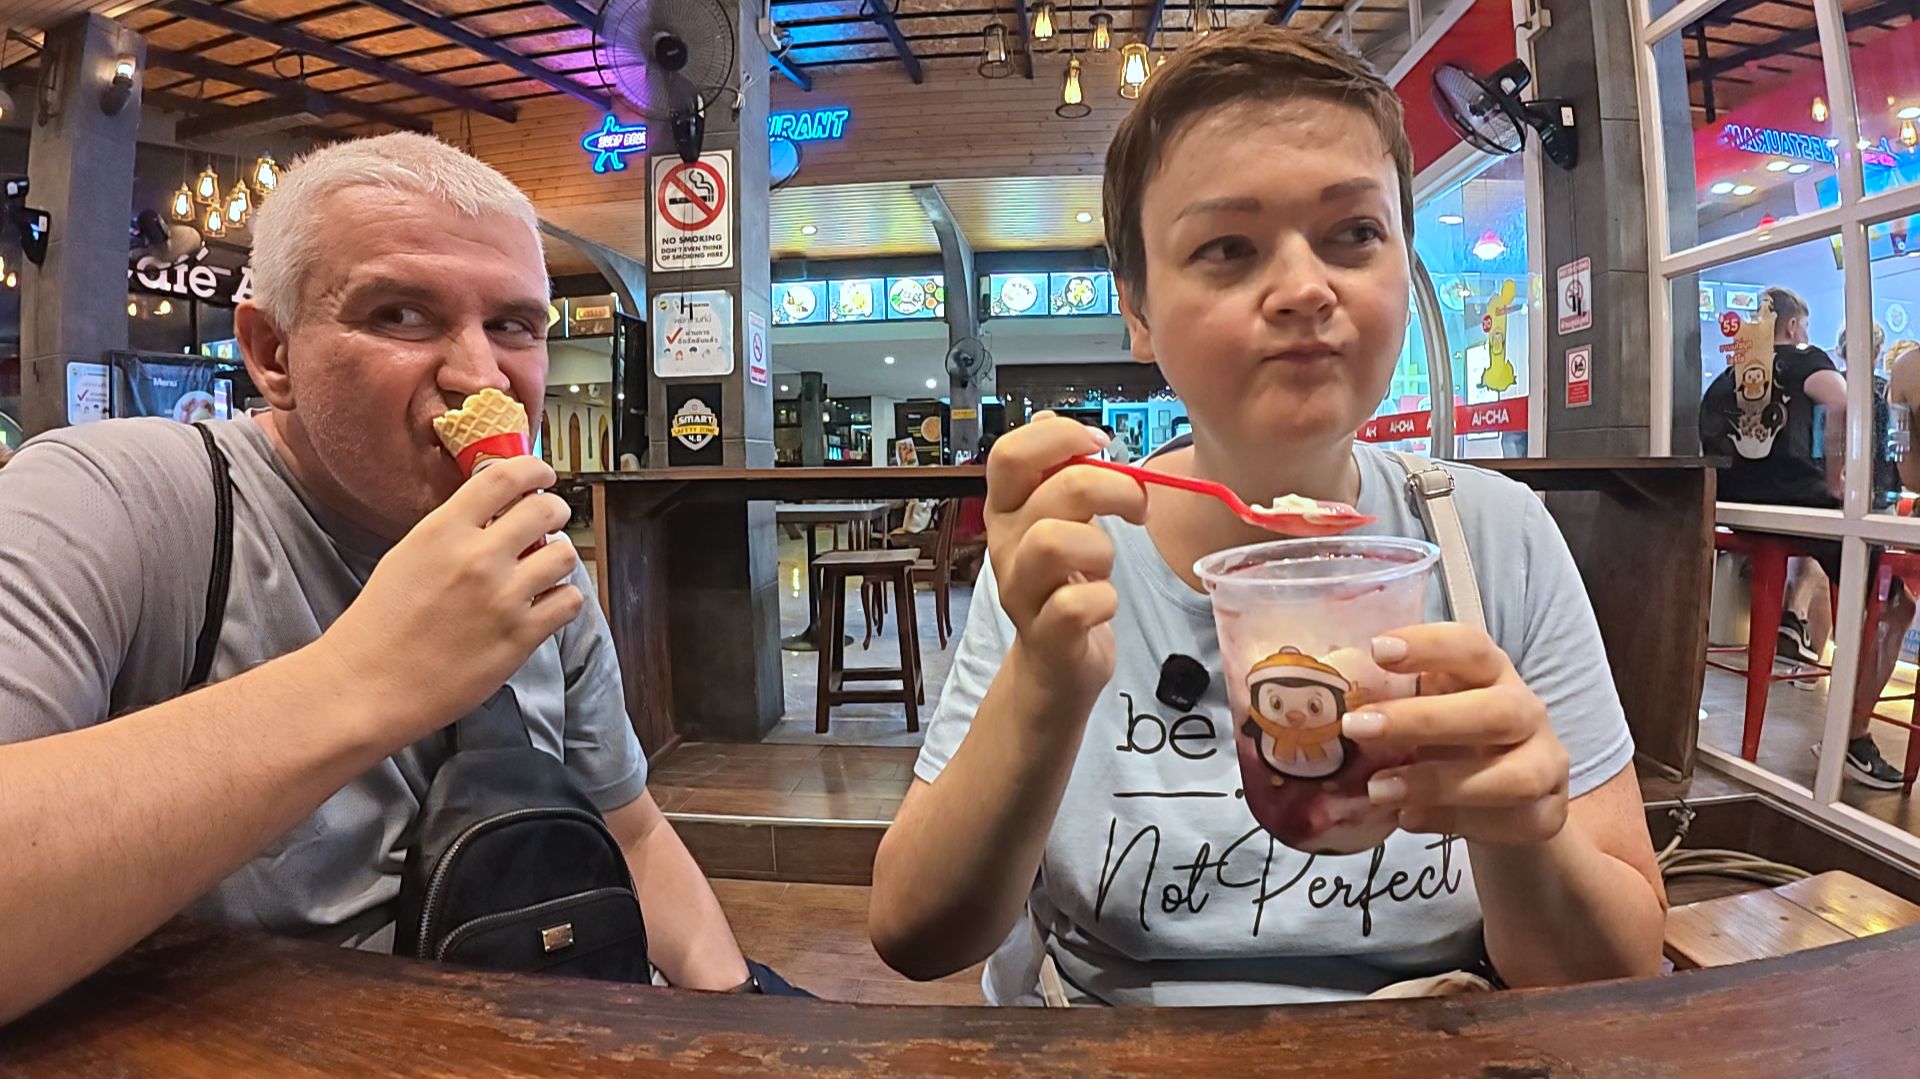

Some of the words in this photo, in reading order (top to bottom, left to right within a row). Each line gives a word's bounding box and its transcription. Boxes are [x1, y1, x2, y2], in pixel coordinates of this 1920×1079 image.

[661, 237, 677, 250] NO
[678, 233, 723, 244] SMOKING
[672, 252, 705, 260] SMOKING
[1723, 318, 1739, 334] 55
[153, 376, 179, 388] Menu
[678, 414, 713, 424] SMART
[1116, 692, 1218, 760] be
[1095, 817, 1228, 932] Not
[1216, 826, 1464, 937] Perfect
